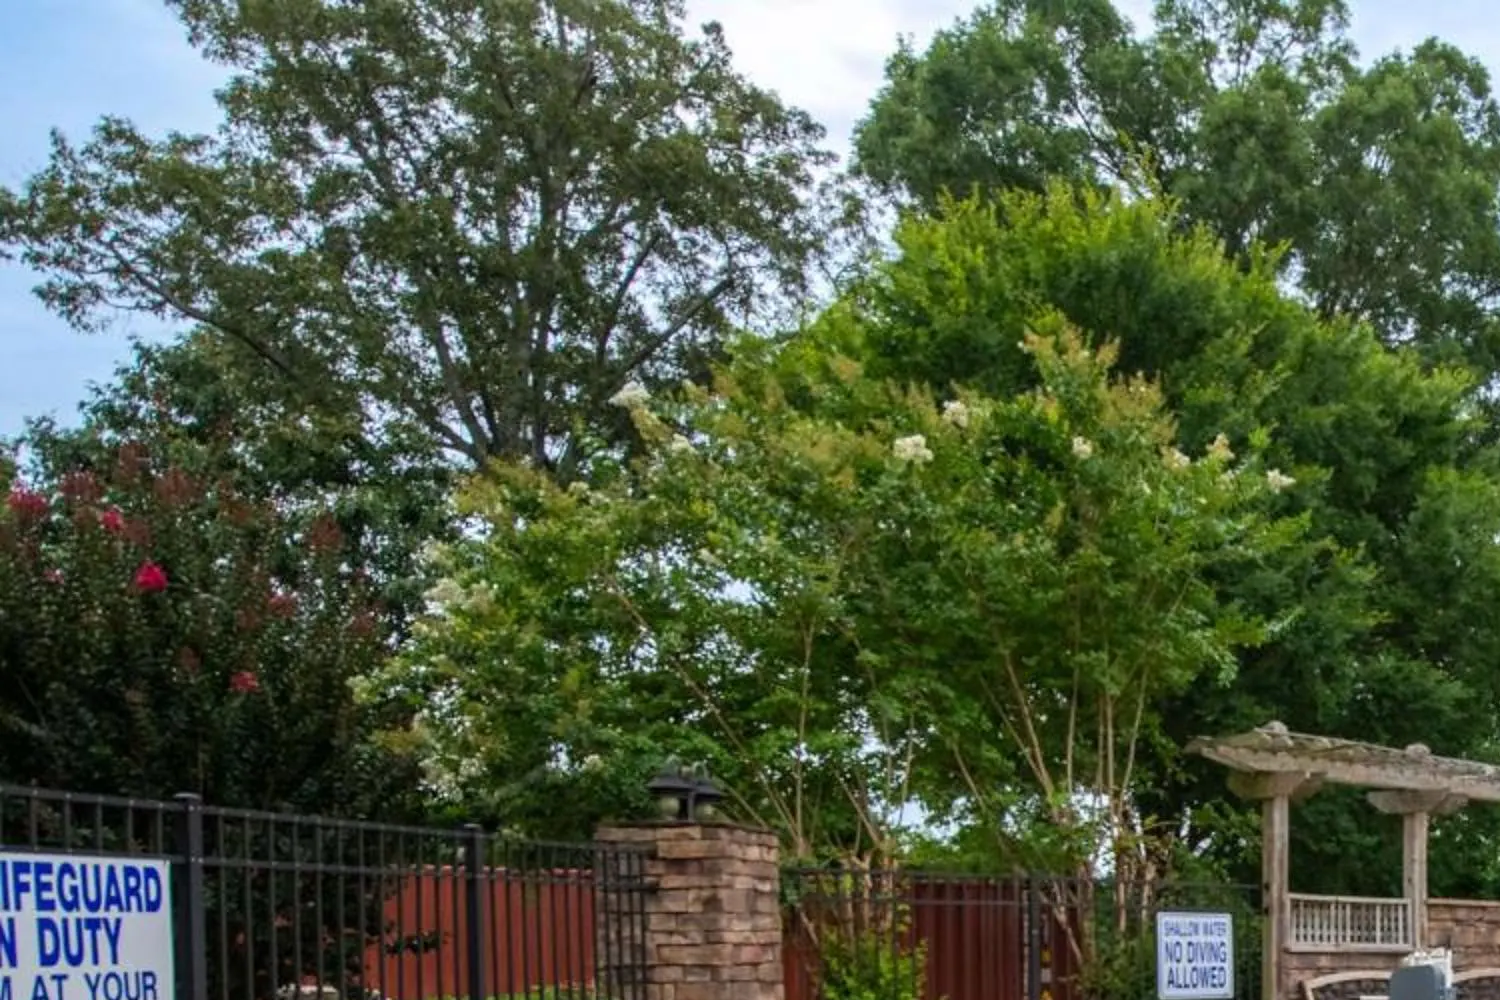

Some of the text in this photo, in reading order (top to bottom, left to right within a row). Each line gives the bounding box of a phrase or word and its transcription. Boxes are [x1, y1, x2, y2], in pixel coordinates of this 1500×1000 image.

[37, 917, 122, 967] DUTY
[1165, 941, 1226, 963] NO DIVING
[1167, 966, 1226, 989] ALLOWED
